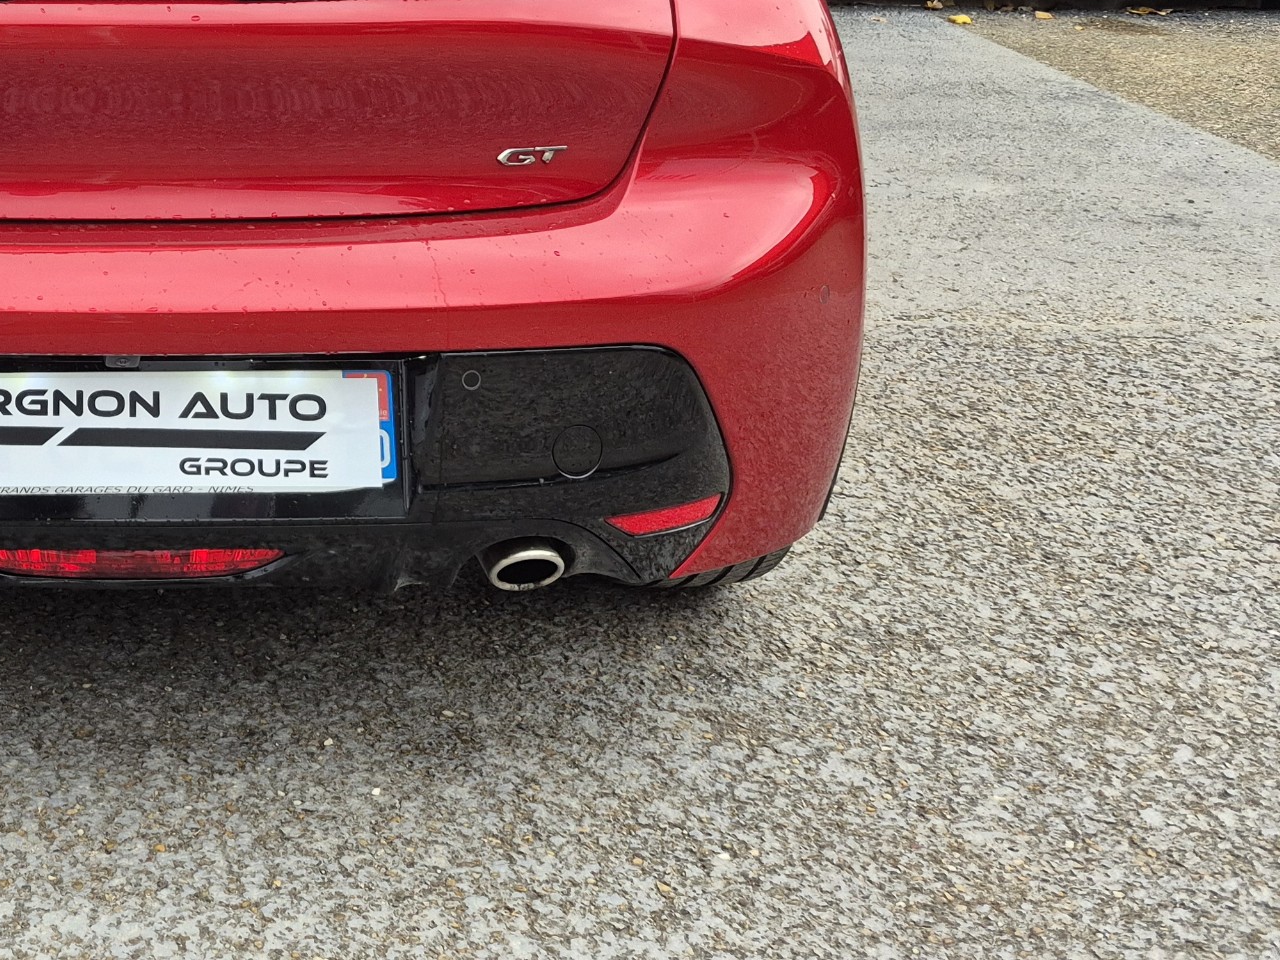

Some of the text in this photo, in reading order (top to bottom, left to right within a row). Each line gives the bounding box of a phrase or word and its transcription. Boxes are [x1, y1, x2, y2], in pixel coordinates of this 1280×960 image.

[496, 145, 569, 167] GT
[178, 391, 328, 422] AUTO
[178, 456, 329, 479] GROUPE
[54, 485, 122, 494] GARAGES
[126, 485, 149, 493] DU
[152, 485, 193, 493] GARD
